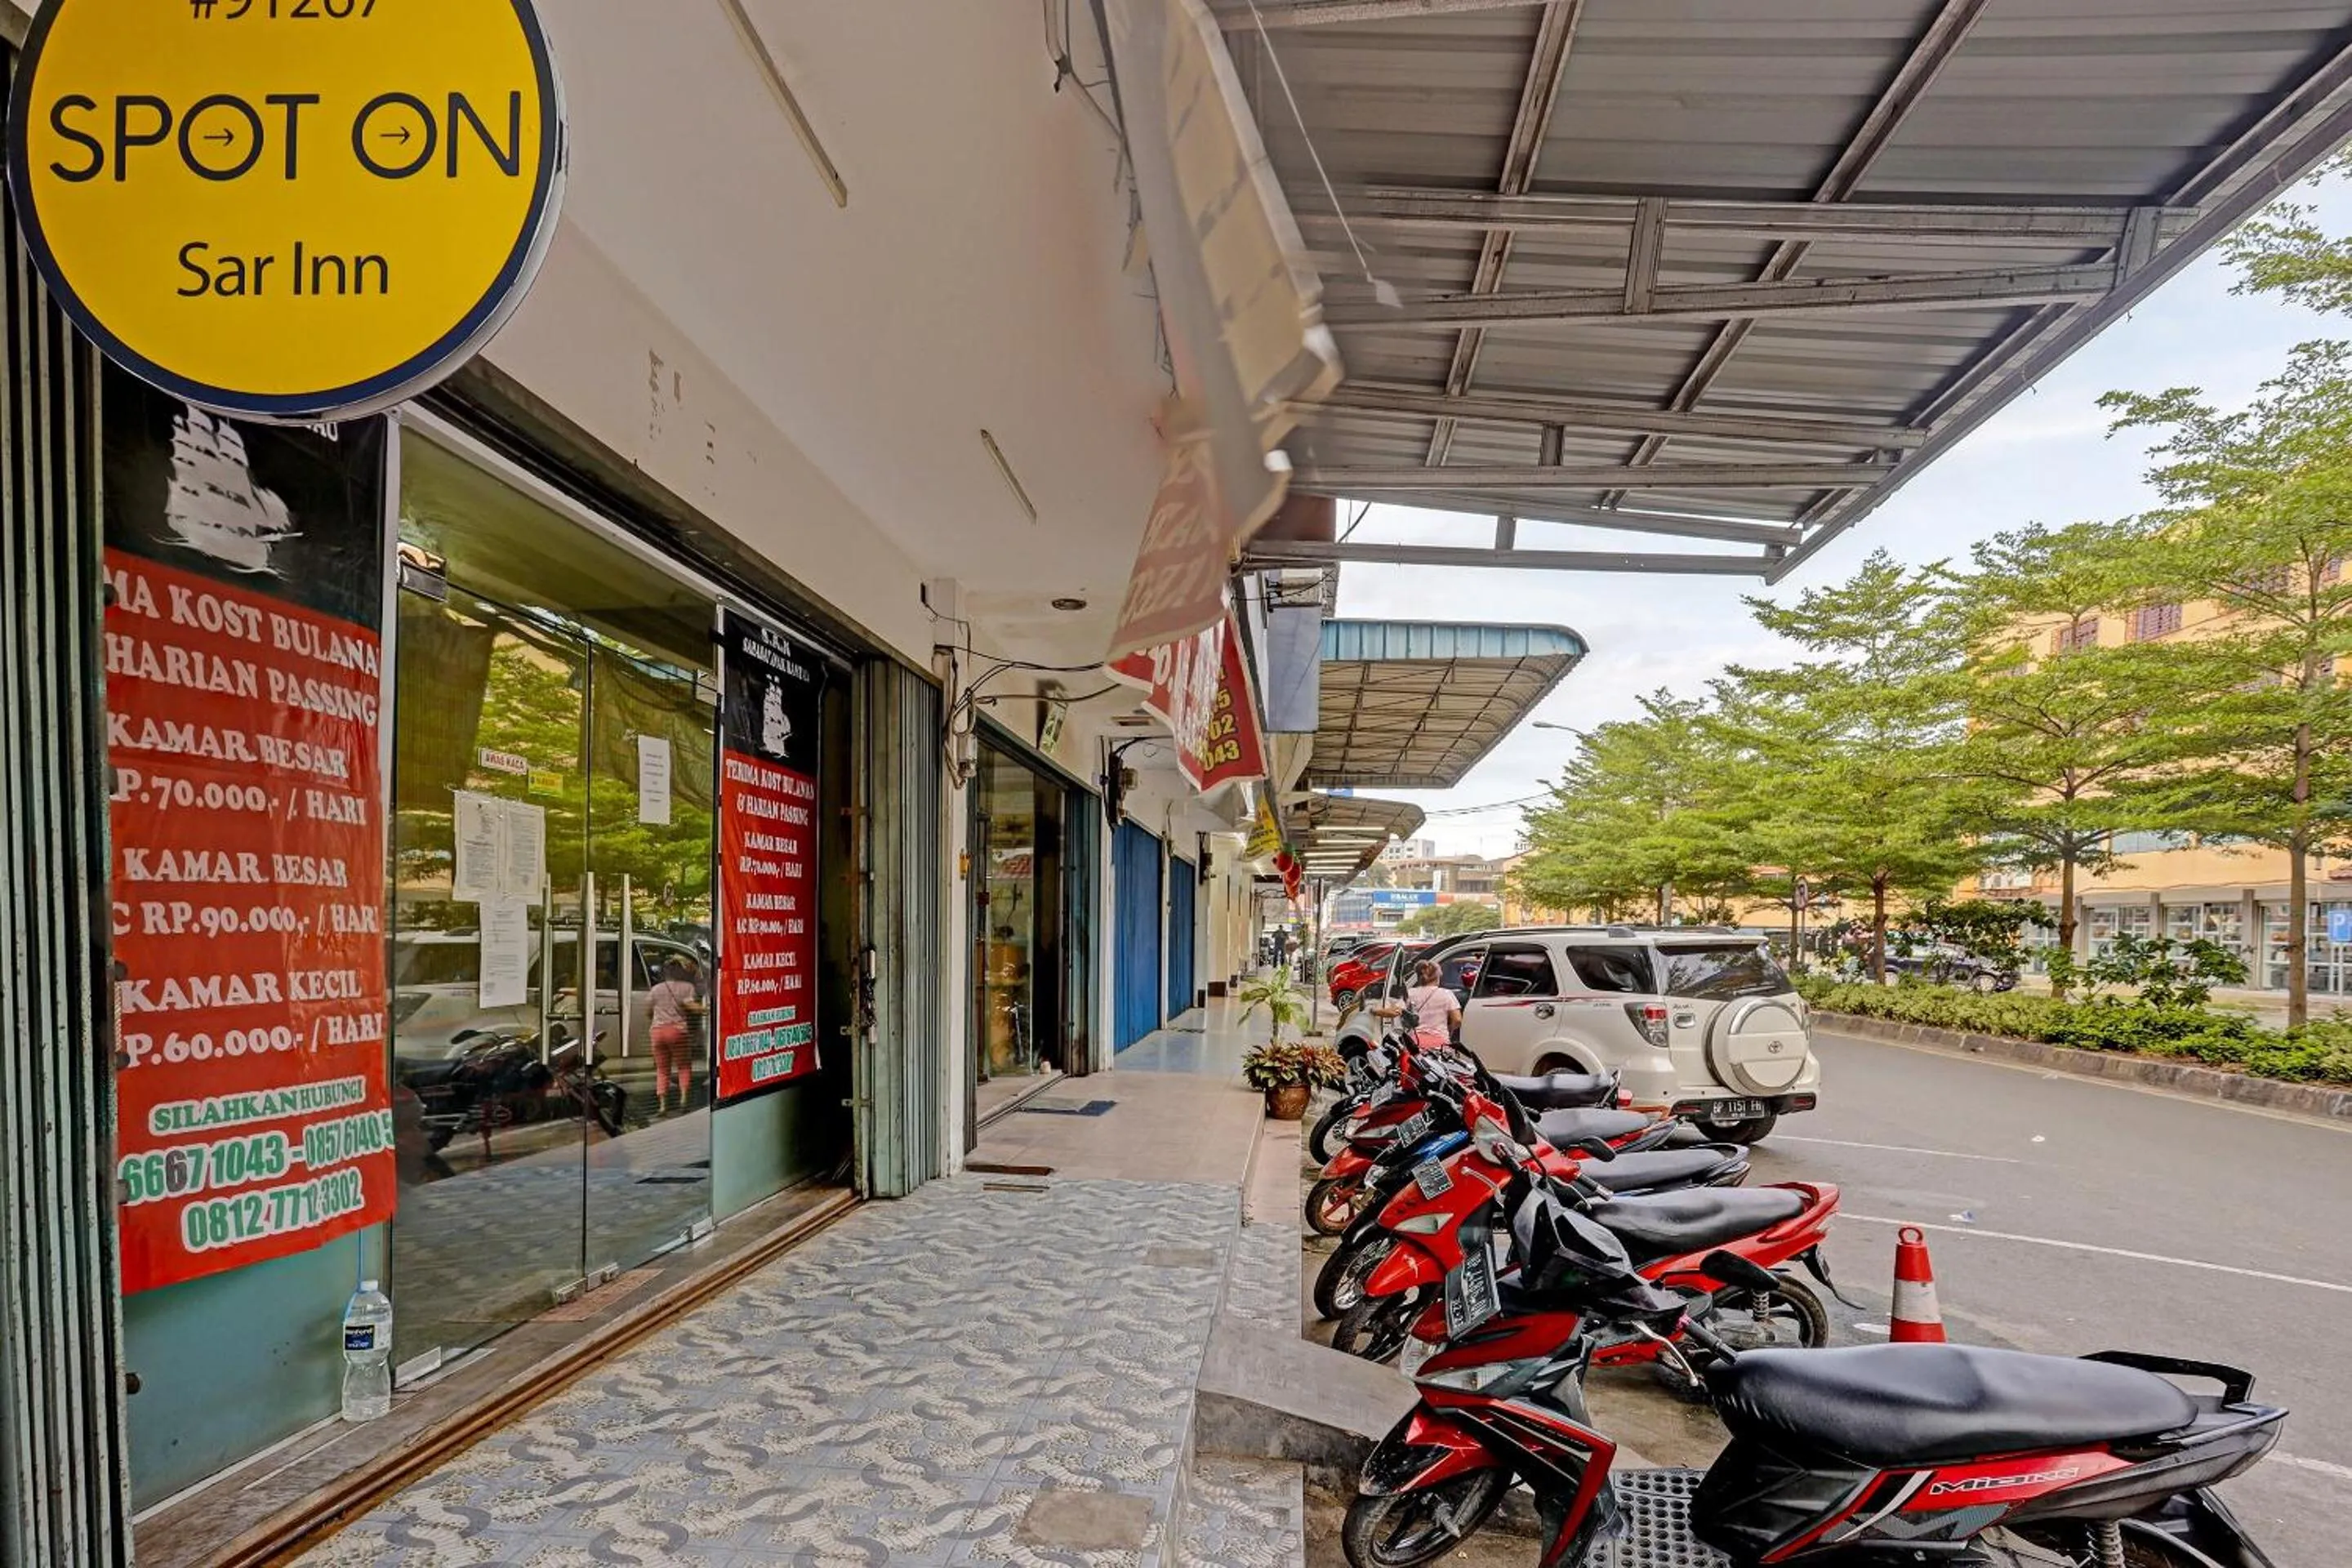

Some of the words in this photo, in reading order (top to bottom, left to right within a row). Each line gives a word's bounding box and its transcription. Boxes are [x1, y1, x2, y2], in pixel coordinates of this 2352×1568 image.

[49, 93, 320, 182] SPOT
[351, 91, 521, 178] ON
[176, 242, 274, 296] Sar
[293, 241, 389, 295] Inn
[167, 584, 261, 641] KOST
[269, 612, 378, 678] BULANA
[105, 632, 258, 700] HARIAN
[266, 667, 376, 727] PASSING
[108, 712, 257, 761] KAMAR
[256, 734, 350, 778] BESAR
[305, 790, 367, 825] HARI
[123, 847, 269, 884] KAMAR
[272, 853, 348, 889] BESAR
[2333, 912, 2345, 929] P
[122, 972, 282, 1013] KAMAR
[287, 969, 363, 1001] KECIL
[327, 1013, 383, 1045] HARI
